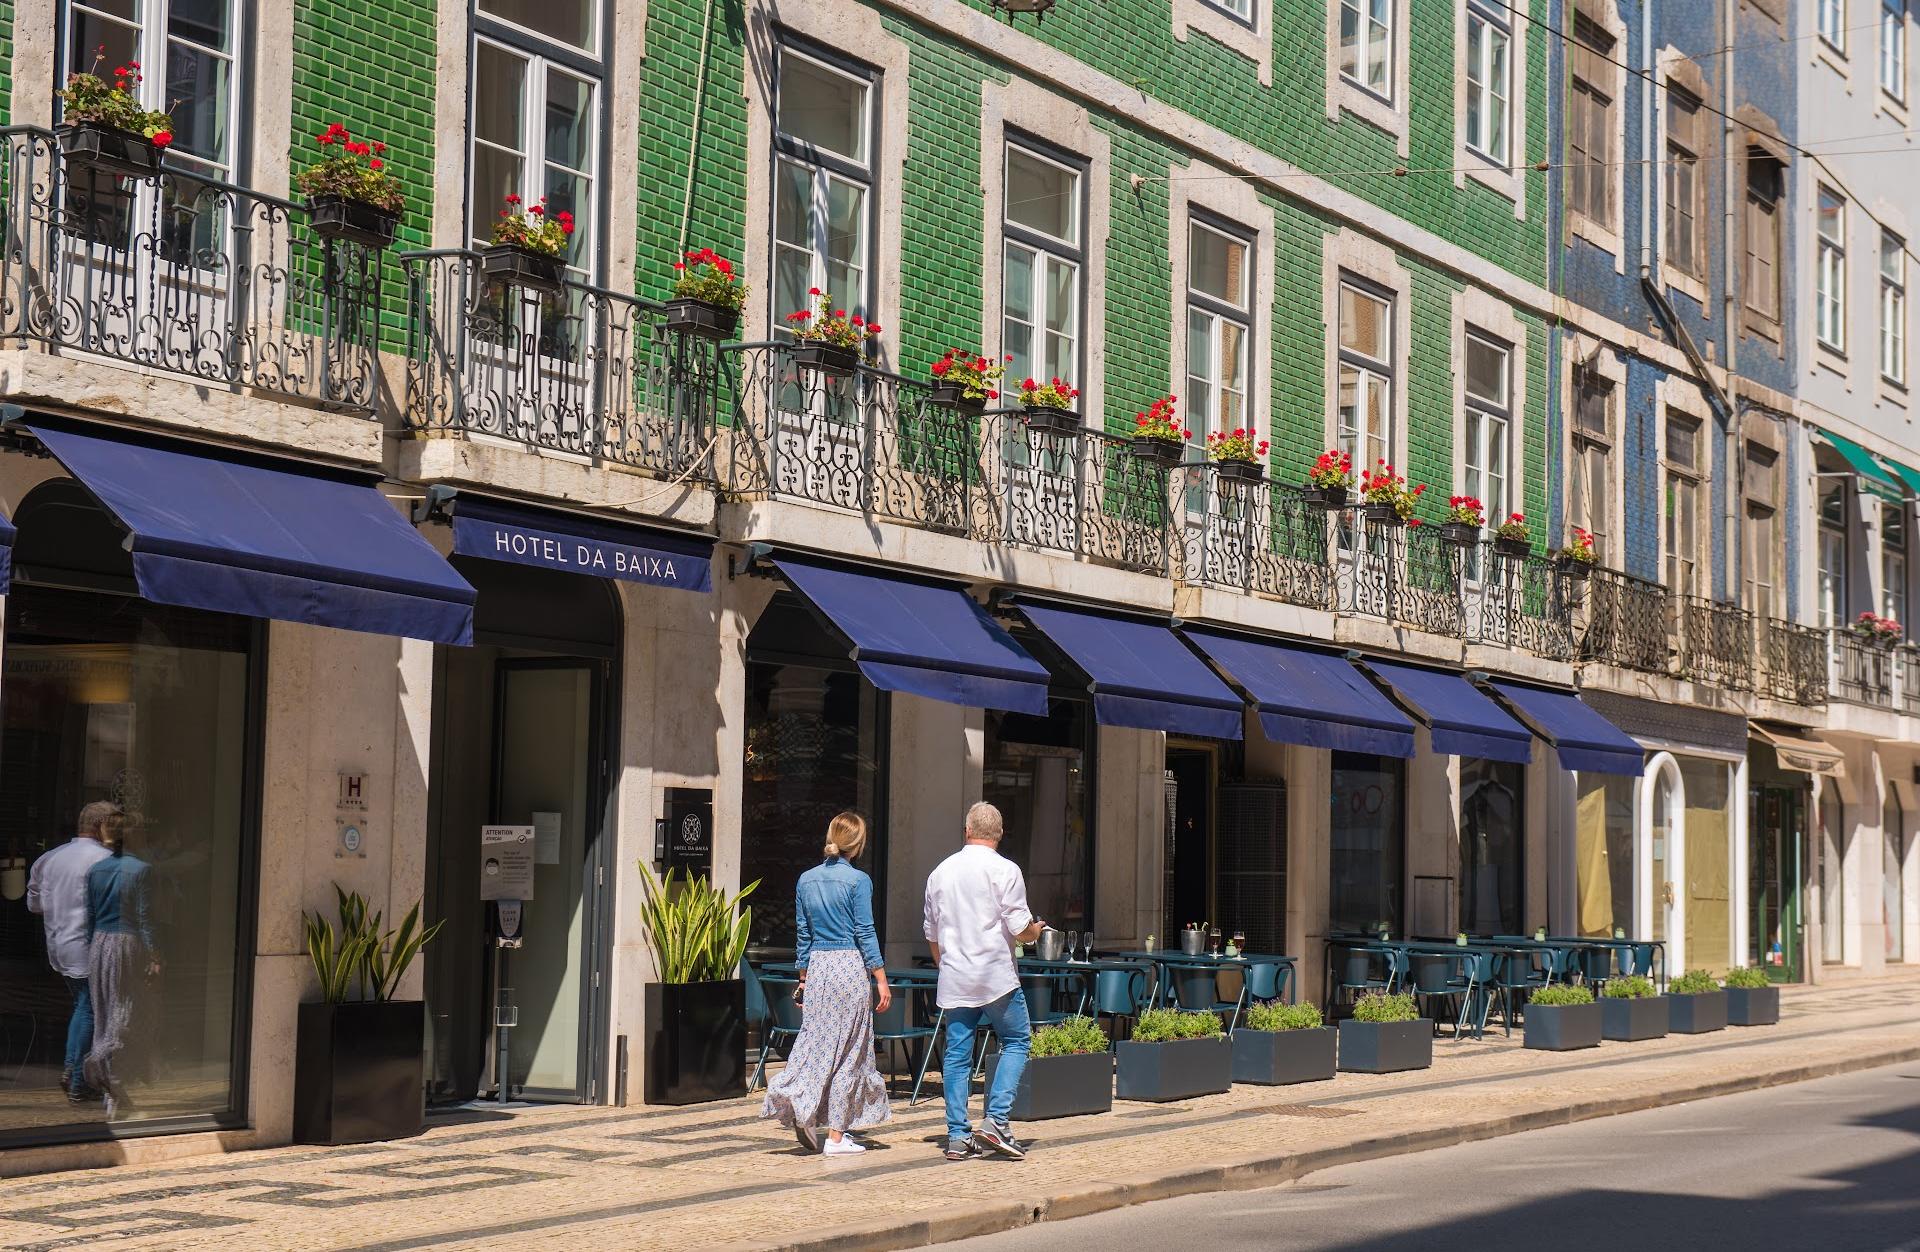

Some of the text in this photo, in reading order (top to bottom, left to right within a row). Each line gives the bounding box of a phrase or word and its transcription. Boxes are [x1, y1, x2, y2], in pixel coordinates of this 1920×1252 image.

[495, 530, 677, 580] HOTEL DA BAIXA
[348, 776, 361, 797] H
